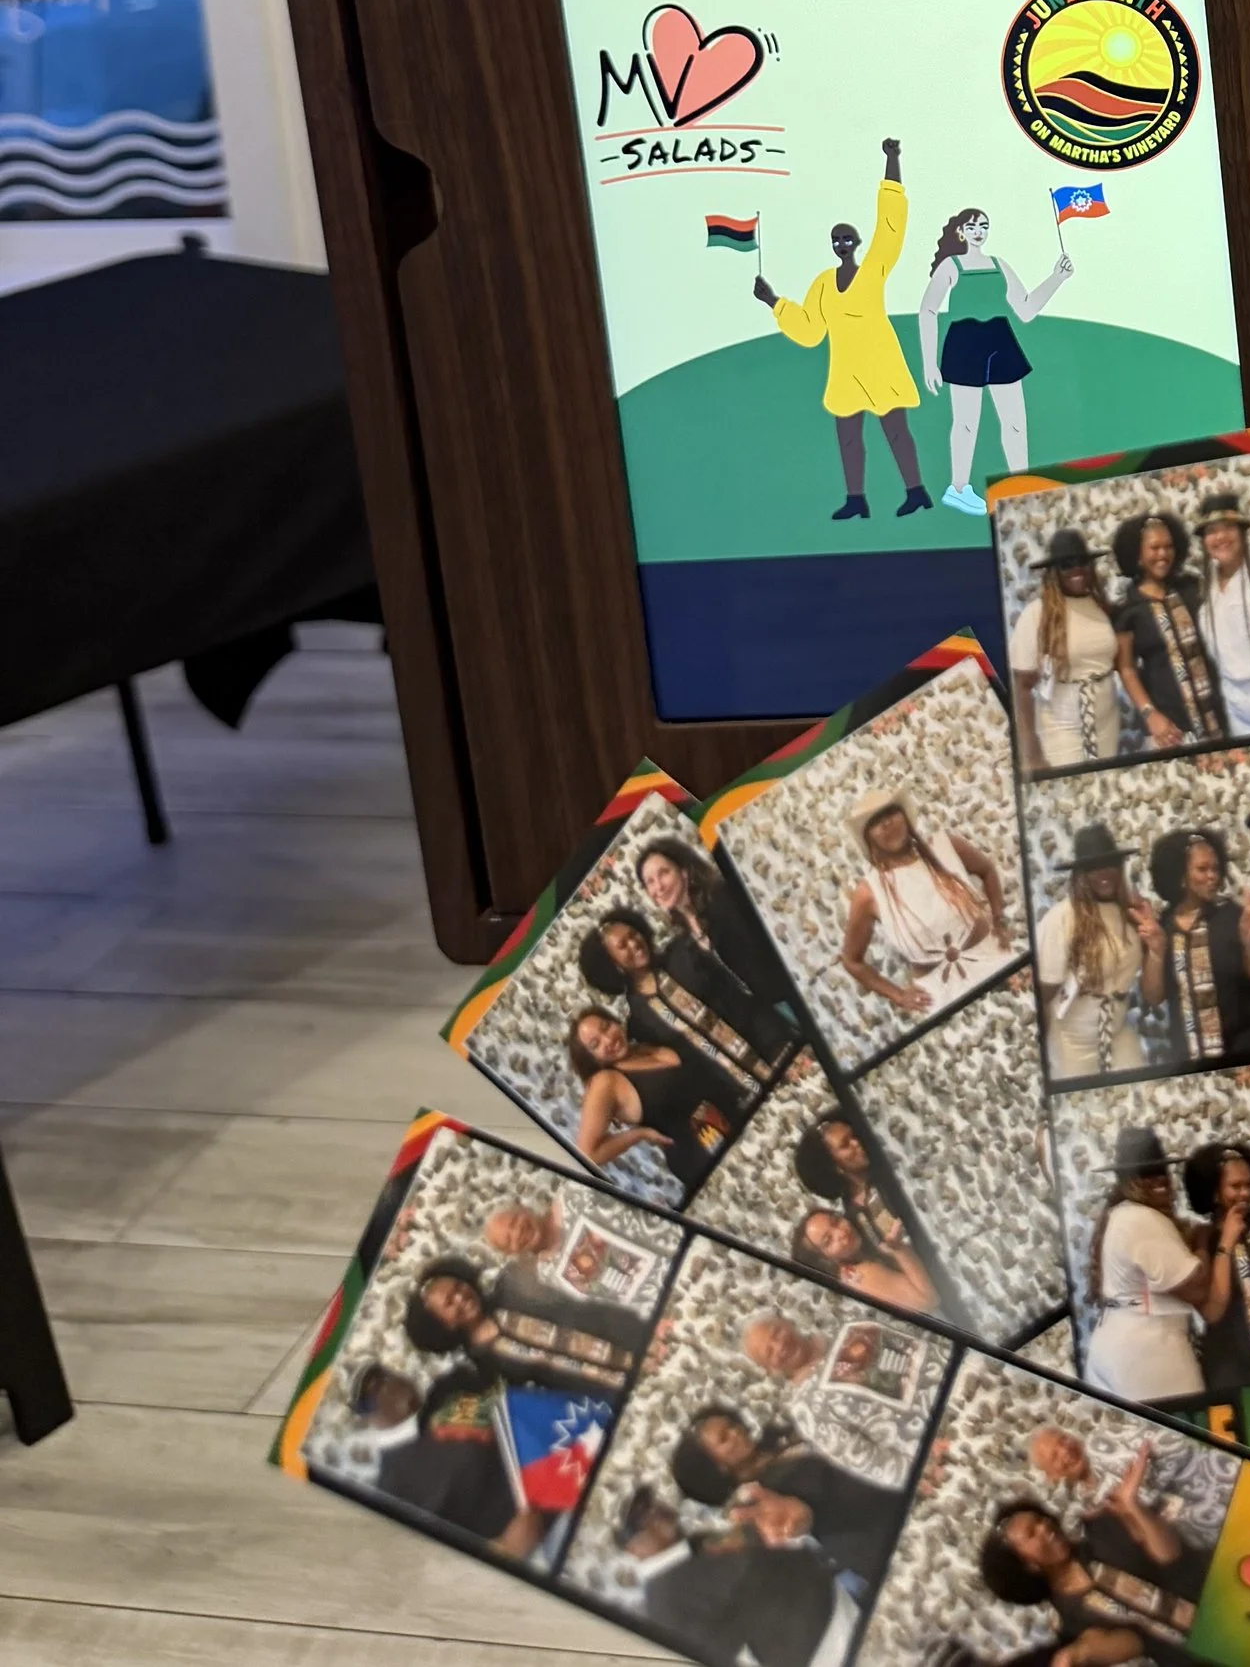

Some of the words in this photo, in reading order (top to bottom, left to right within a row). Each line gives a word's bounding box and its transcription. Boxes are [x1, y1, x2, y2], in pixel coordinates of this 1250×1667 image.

[1030, 118, 1052, 142] ON
[1048, 134, 1122, 164] MARTHA'S
[1122, 110, 1182, 161] VINEYARD
